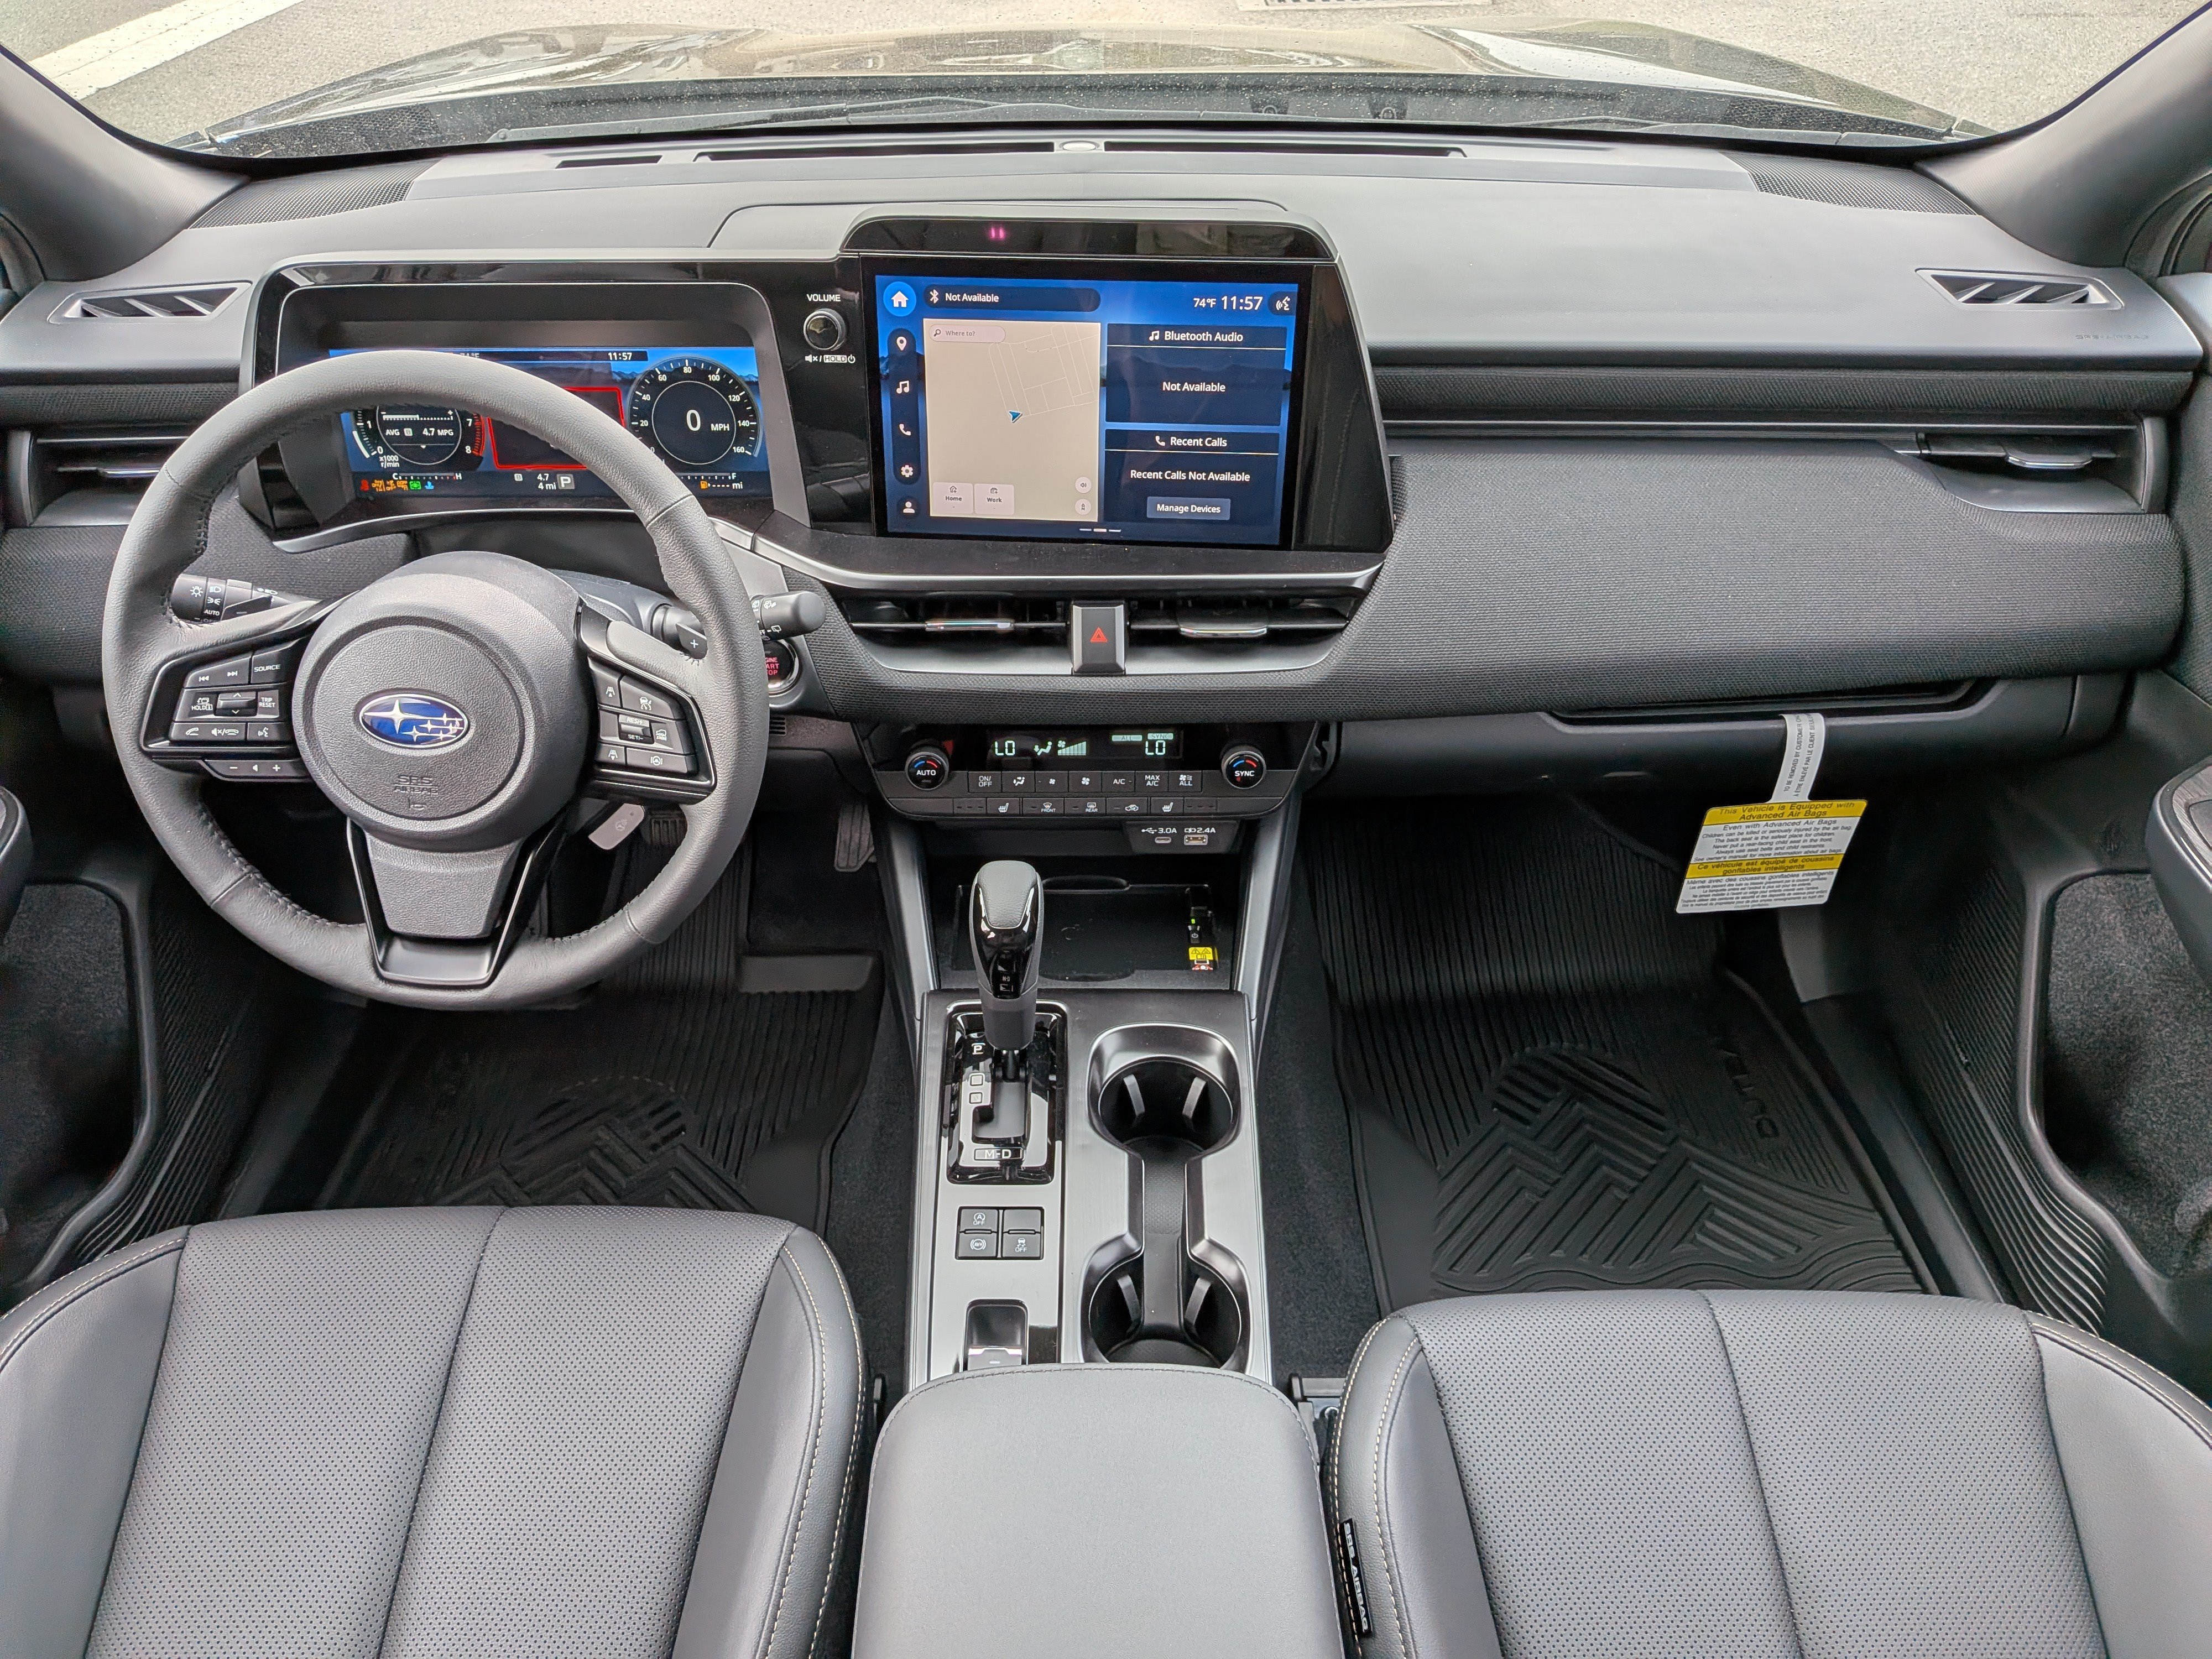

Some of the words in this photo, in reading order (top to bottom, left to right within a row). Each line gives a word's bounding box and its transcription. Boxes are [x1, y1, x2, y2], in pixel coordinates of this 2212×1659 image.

[806, 294, 841, 302] VOLUME
[945, 294, 961, 302] Not
[962, 294, 999, 302] Available
[1193, 298, 1216, 308] 74°F
[1222, 296, 1263, 310] 11:57
[1165, 331, 1212, 341] Bluetooth
[1214, 332, 1244, 342] Audio
[608, 352, 633, 361] 11:57
[1162, 382, 1180, 391] Not
[1182, 382, 1225, 392] Available
[367, 420, 372, 429] 1
[686, 409, 701, 431] 0
[711, 423, 730, 431] MPH
[1171, 437, 1203, 446] Recent
[1205, 437, 1227, 446] Calls
[377, 446, 383, 454] 0
[465, 446, 472, 454] 8
[1130, 470, 1162, 479] Recent
[1165, 470, 1187, 479] Calls
[1188, 472, 1206, 480] Not
[1208, 472, 1250, 482] Available
[545, 482, 556, 490] mi
[560, 476, 572, 487] P
[1157, 504, 1189, 514] Manage
[1191, 504, 1220, 513] Devices
[995, 740, 1015, 756] LO
[1145, 740, 1166, 755] LO
[1788, 758, 1798, 779] REMOVED
[1795, 723, 1803, 750] CUSTOMER
[1803, 756, 1812, 766] PAR
[1789, 802, 1833, 811] Equipped
[1739, 811, 1784, 820] Advanced
[1803, 810, 1827, 818] Bags
[1723, 867, 1761, 875] gonflables
[973, 1045, 983, 1053] P
